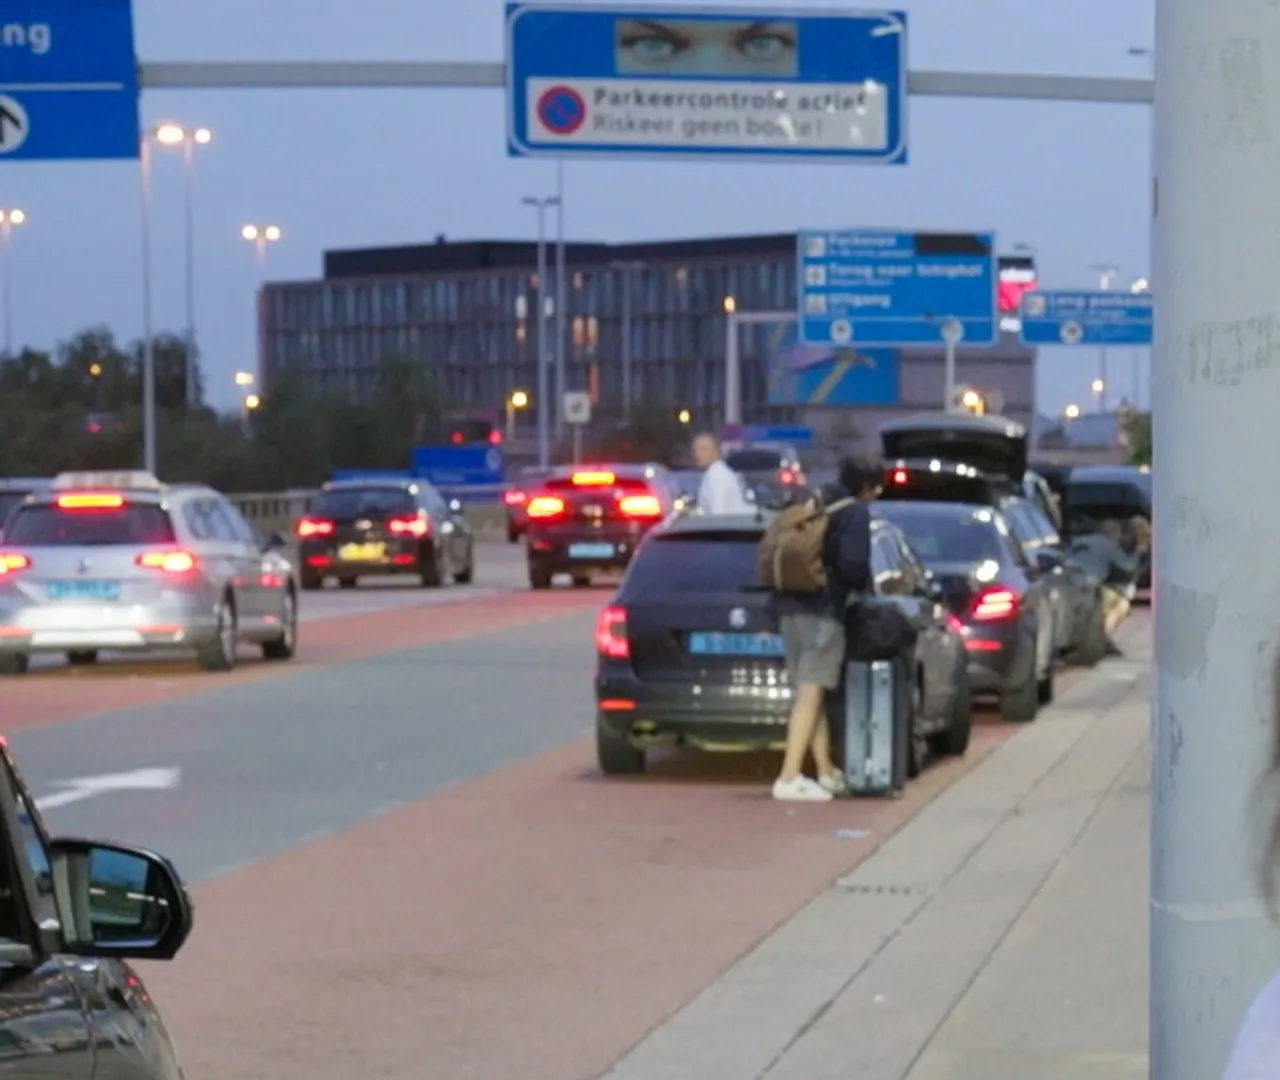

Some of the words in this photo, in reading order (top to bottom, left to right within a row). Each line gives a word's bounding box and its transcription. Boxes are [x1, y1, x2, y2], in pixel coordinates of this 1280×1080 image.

[0, 22, 52, 55] ng
[593, 86, 788, 110] Parkeercontrole
[797, 91, 868, 112] actief
[593, 114, 674, 133] Riskeer
[682, 119, 741, 140] geen
